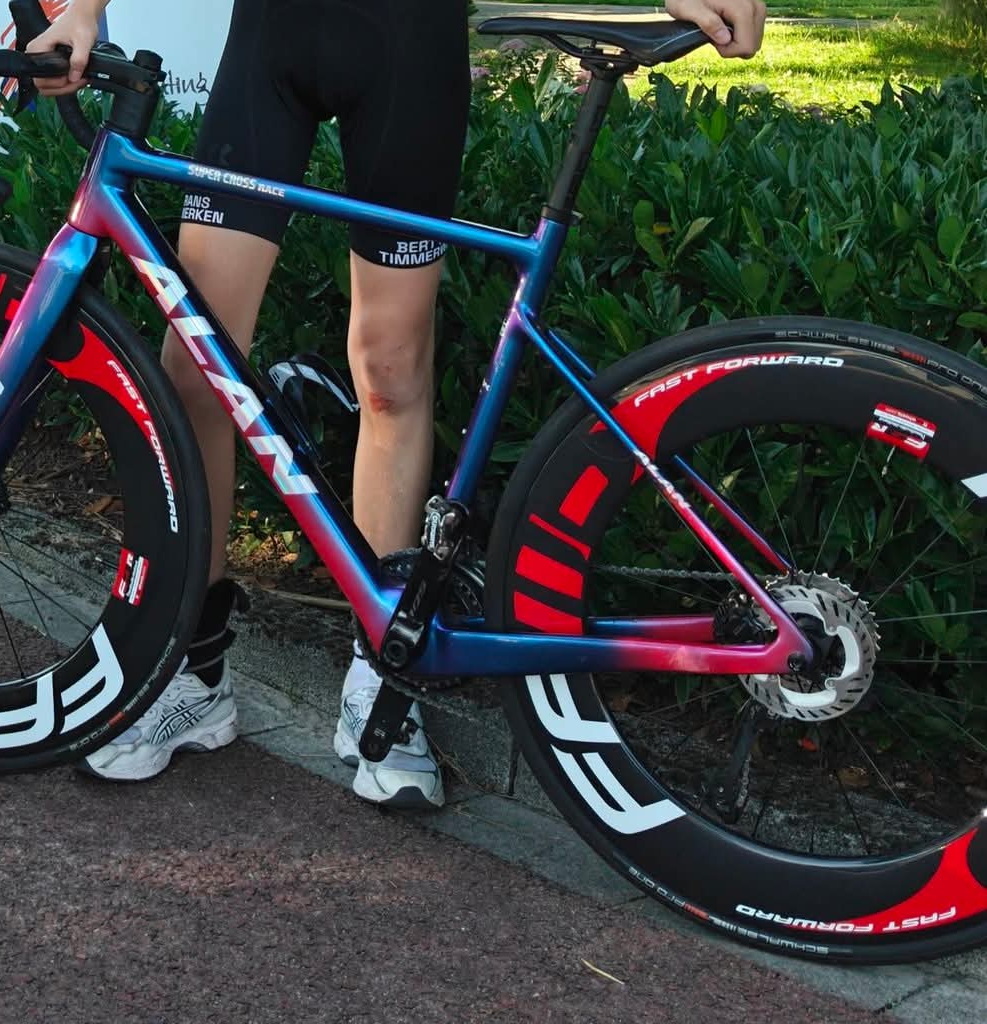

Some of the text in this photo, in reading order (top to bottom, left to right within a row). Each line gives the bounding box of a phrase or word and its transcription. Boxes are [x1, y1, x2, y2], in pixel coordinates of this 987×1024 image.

[128, 254, 319, 495] ALAN
[634, 354, 845, 407] FAST FORWARD
[106, 359, 178, 534] FAST FORWARD
[735, 904, 873, 933] FORWARD
[883, 907, 956, 931] FAST
